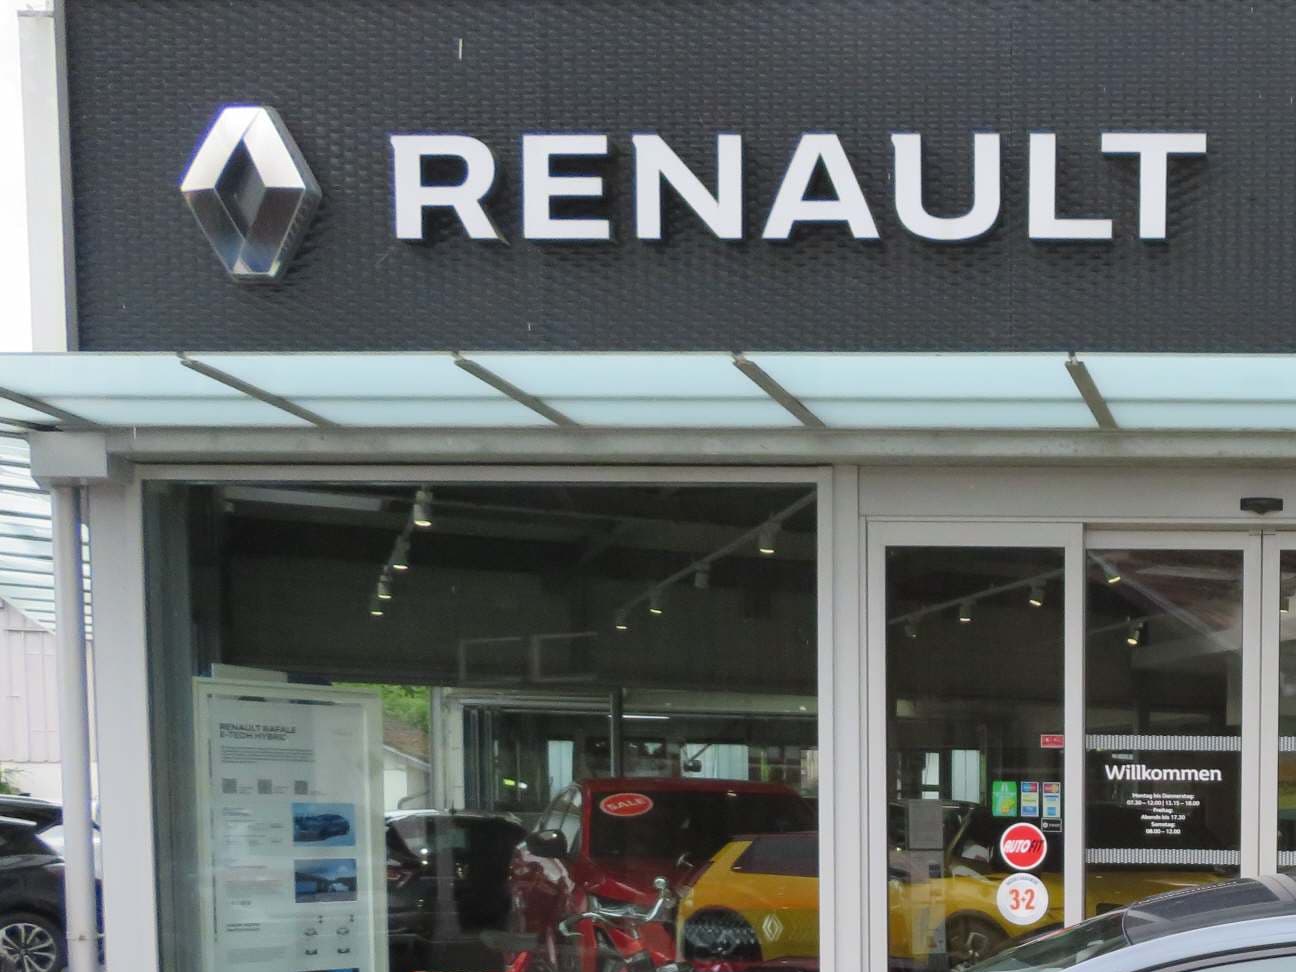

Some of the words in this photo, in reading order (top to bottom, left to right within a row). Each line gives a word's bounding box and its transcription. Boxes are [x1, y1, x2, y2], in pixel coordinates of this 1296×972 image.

[389, 132, 1207, 241] RENAULT
[1105, 764, 1222, 781] Willkommen
[607, 798, 646, 810] SALE
